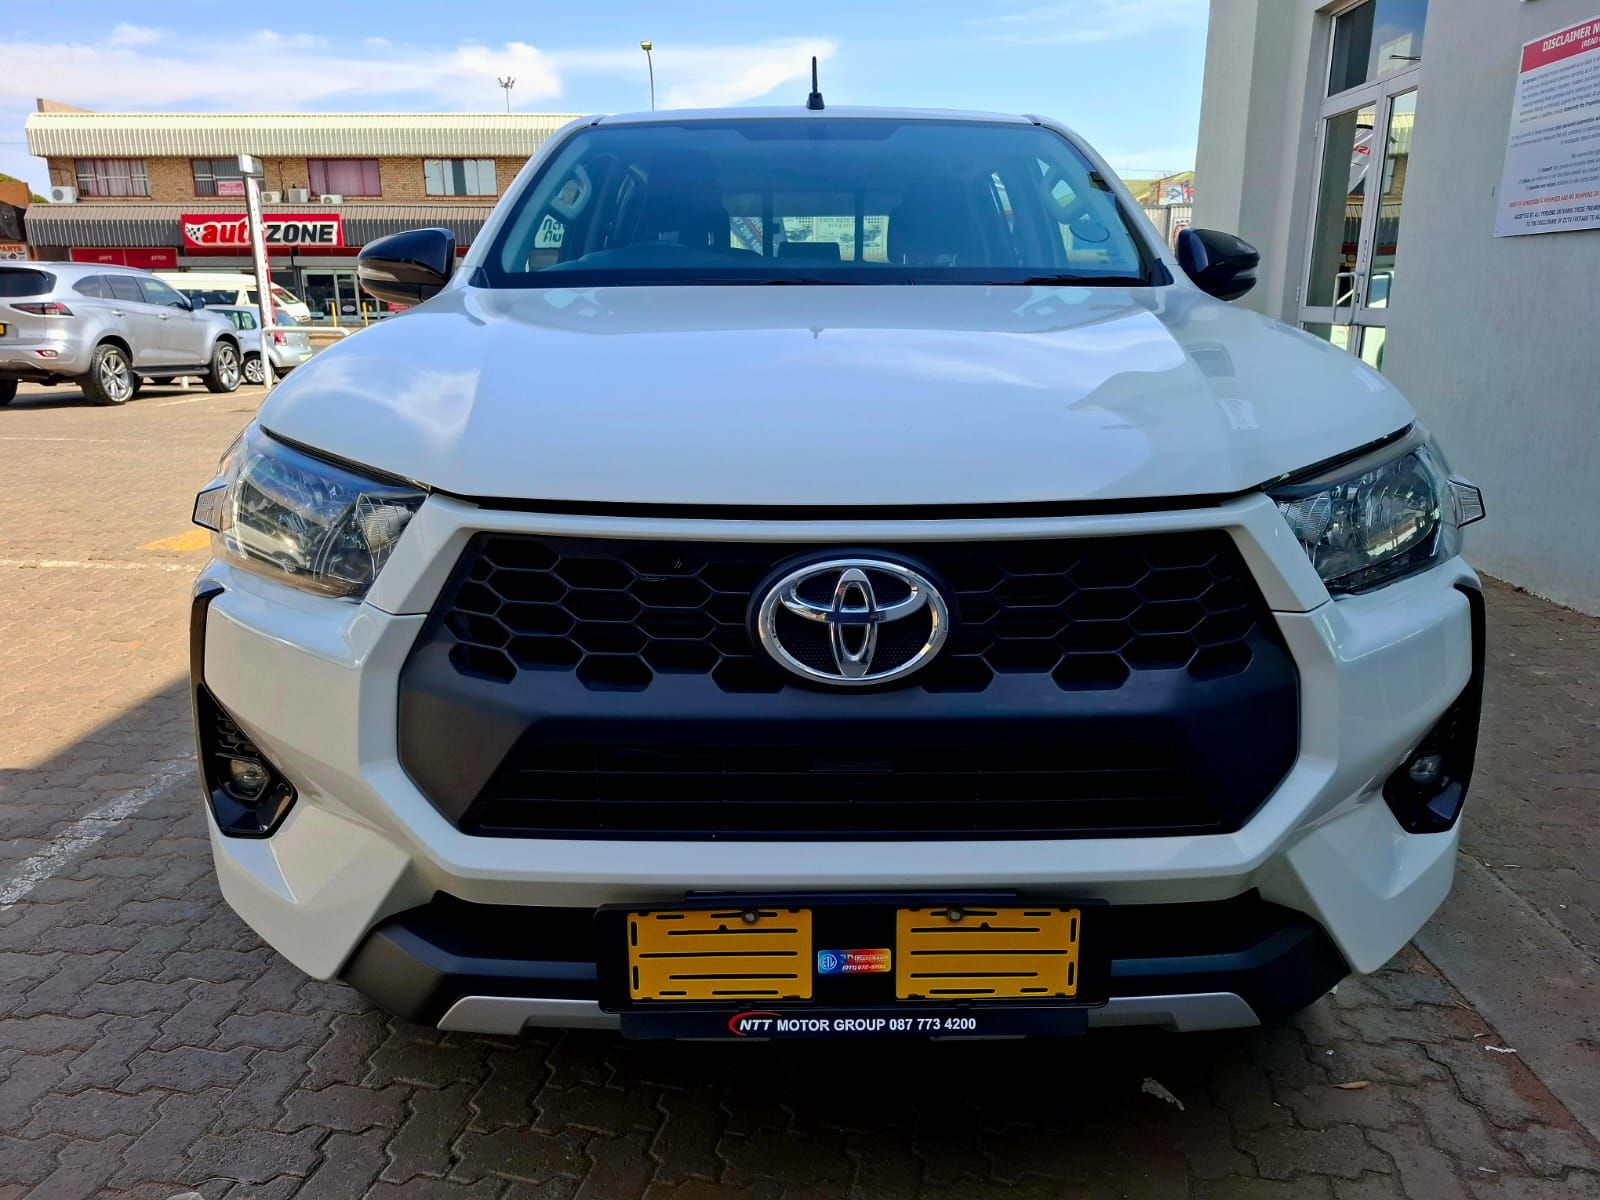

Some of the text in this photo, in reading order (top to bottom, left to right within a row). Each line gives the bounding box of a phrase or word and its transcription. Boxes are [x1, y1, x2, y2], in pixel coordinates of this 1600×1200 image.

[1542, 25, 1592, 52] DISCLAIMER
[266, 224, 334, 243] ZONE
[739, 1018, 976, 1031] NTT MOTOR GROUP 087 773 4200
